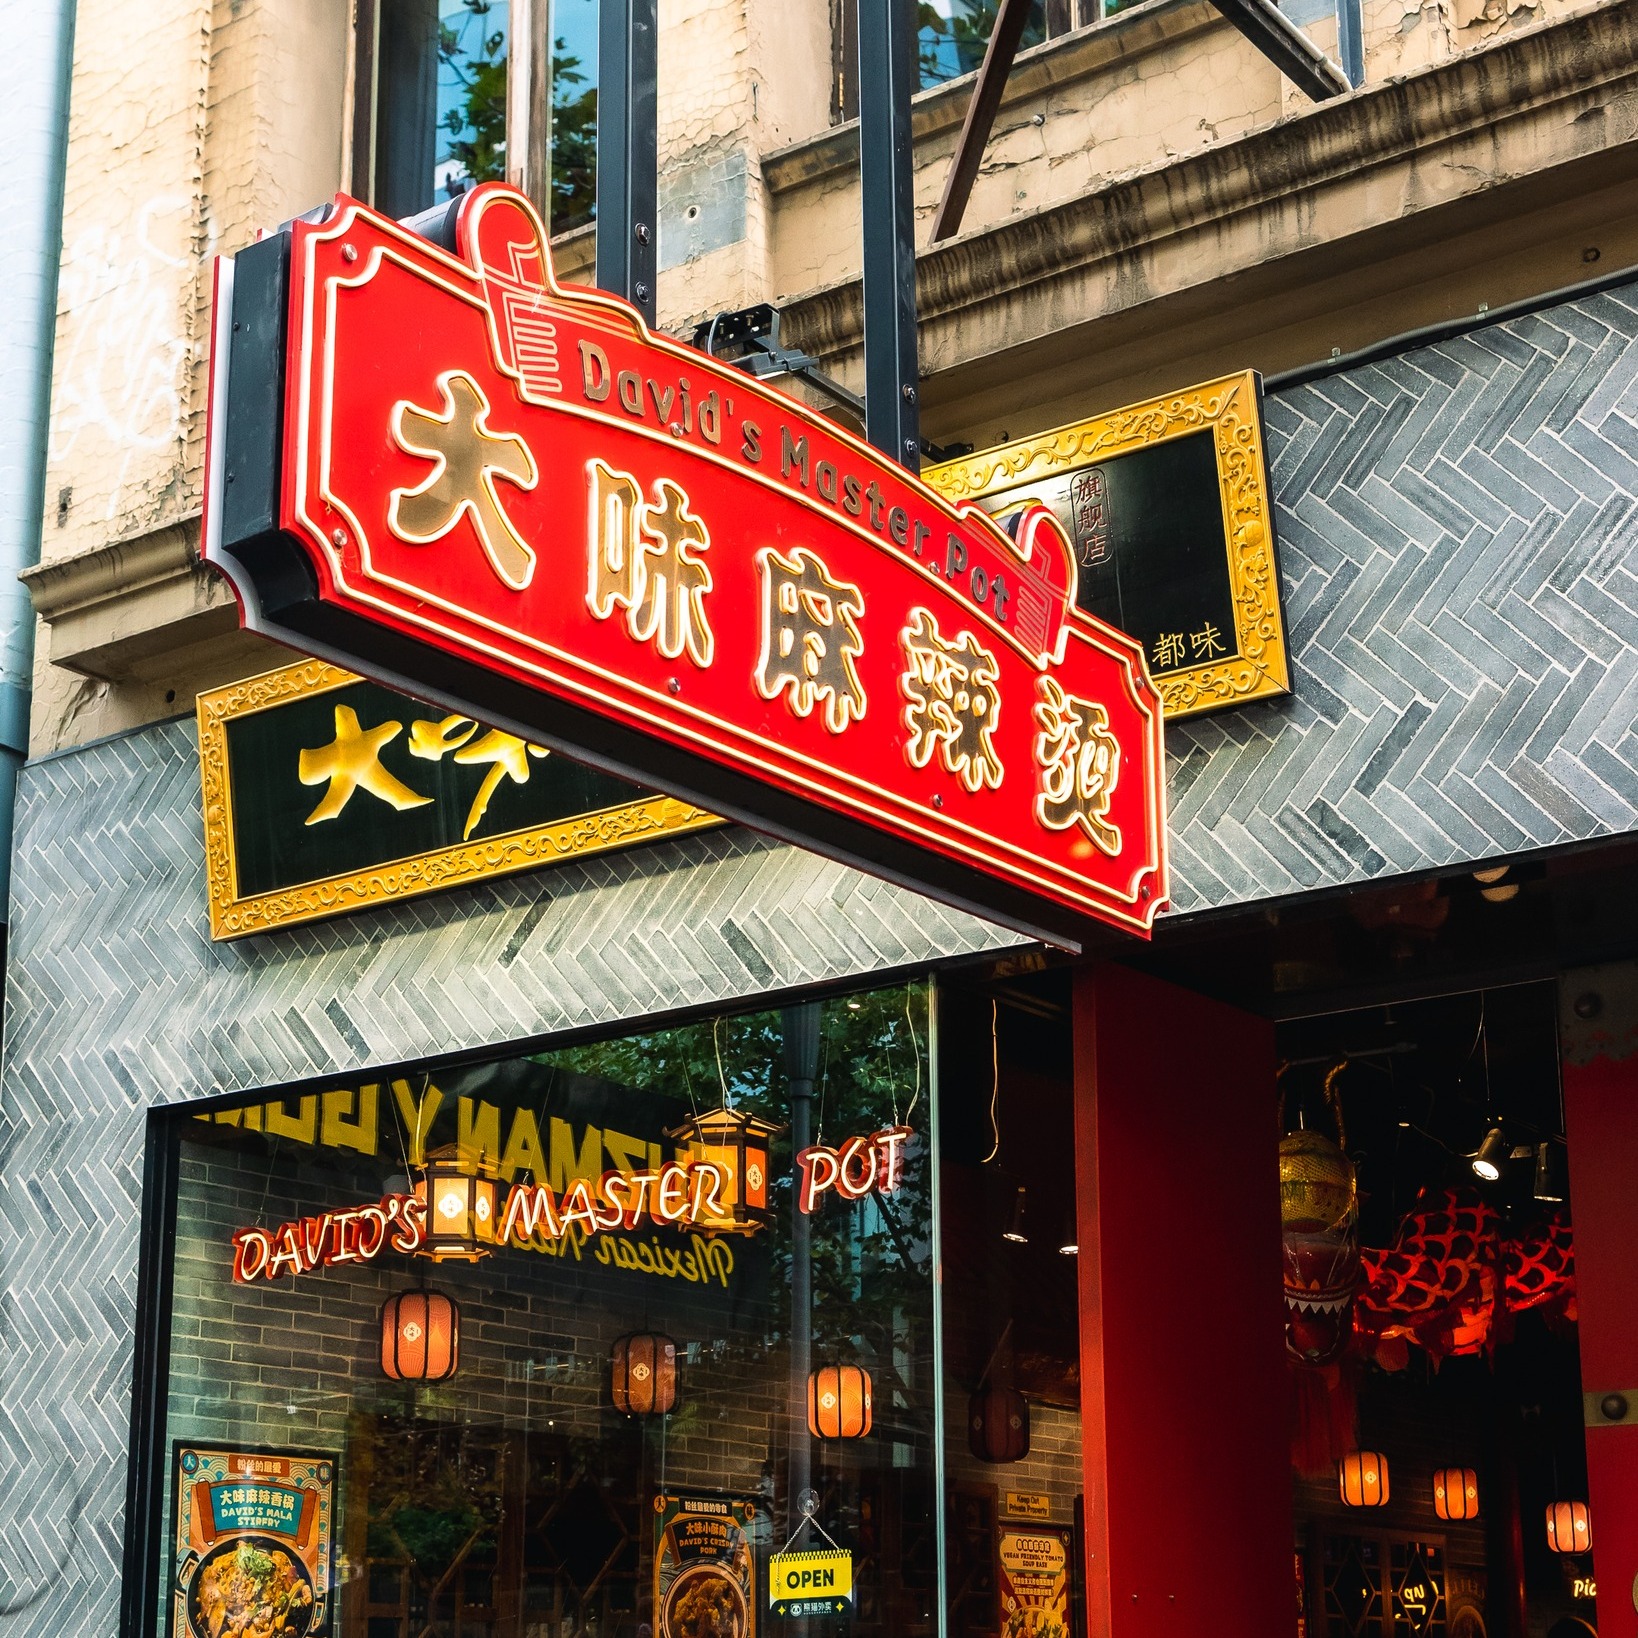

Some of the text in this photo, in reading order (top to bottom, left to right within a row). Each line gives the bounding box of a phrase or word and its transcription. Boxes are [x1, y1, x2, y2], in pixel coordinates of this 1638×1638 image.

[577, 338, 1011, 624] David's Master Pot
[1074, 475, 1108, 563] 旗舰店
[387, 370, 1124, 858] 大味麻辣烫
[233, 1193, 425, 1283] DAVID'S
[497, 1161, 729, 1244] MASTER
[797, 1126, 914, 1213] POT
[220, 1489, 295, 1511] 大味麻辣香锅
[221, 1506, 293, 1522] DAVID'S MALA
[237, 1516, 281, 1528] STIRFRY
[679, 1537, 735, 1549] DAVID'S CRISPY
[699, 1546, 718, 1555] PORK
[1022, 1560, 1035, 1568] SOUP
[1045, 1555, 1064, 1563] TOMATO
[786, 1568, 834, 1590] OPEN
